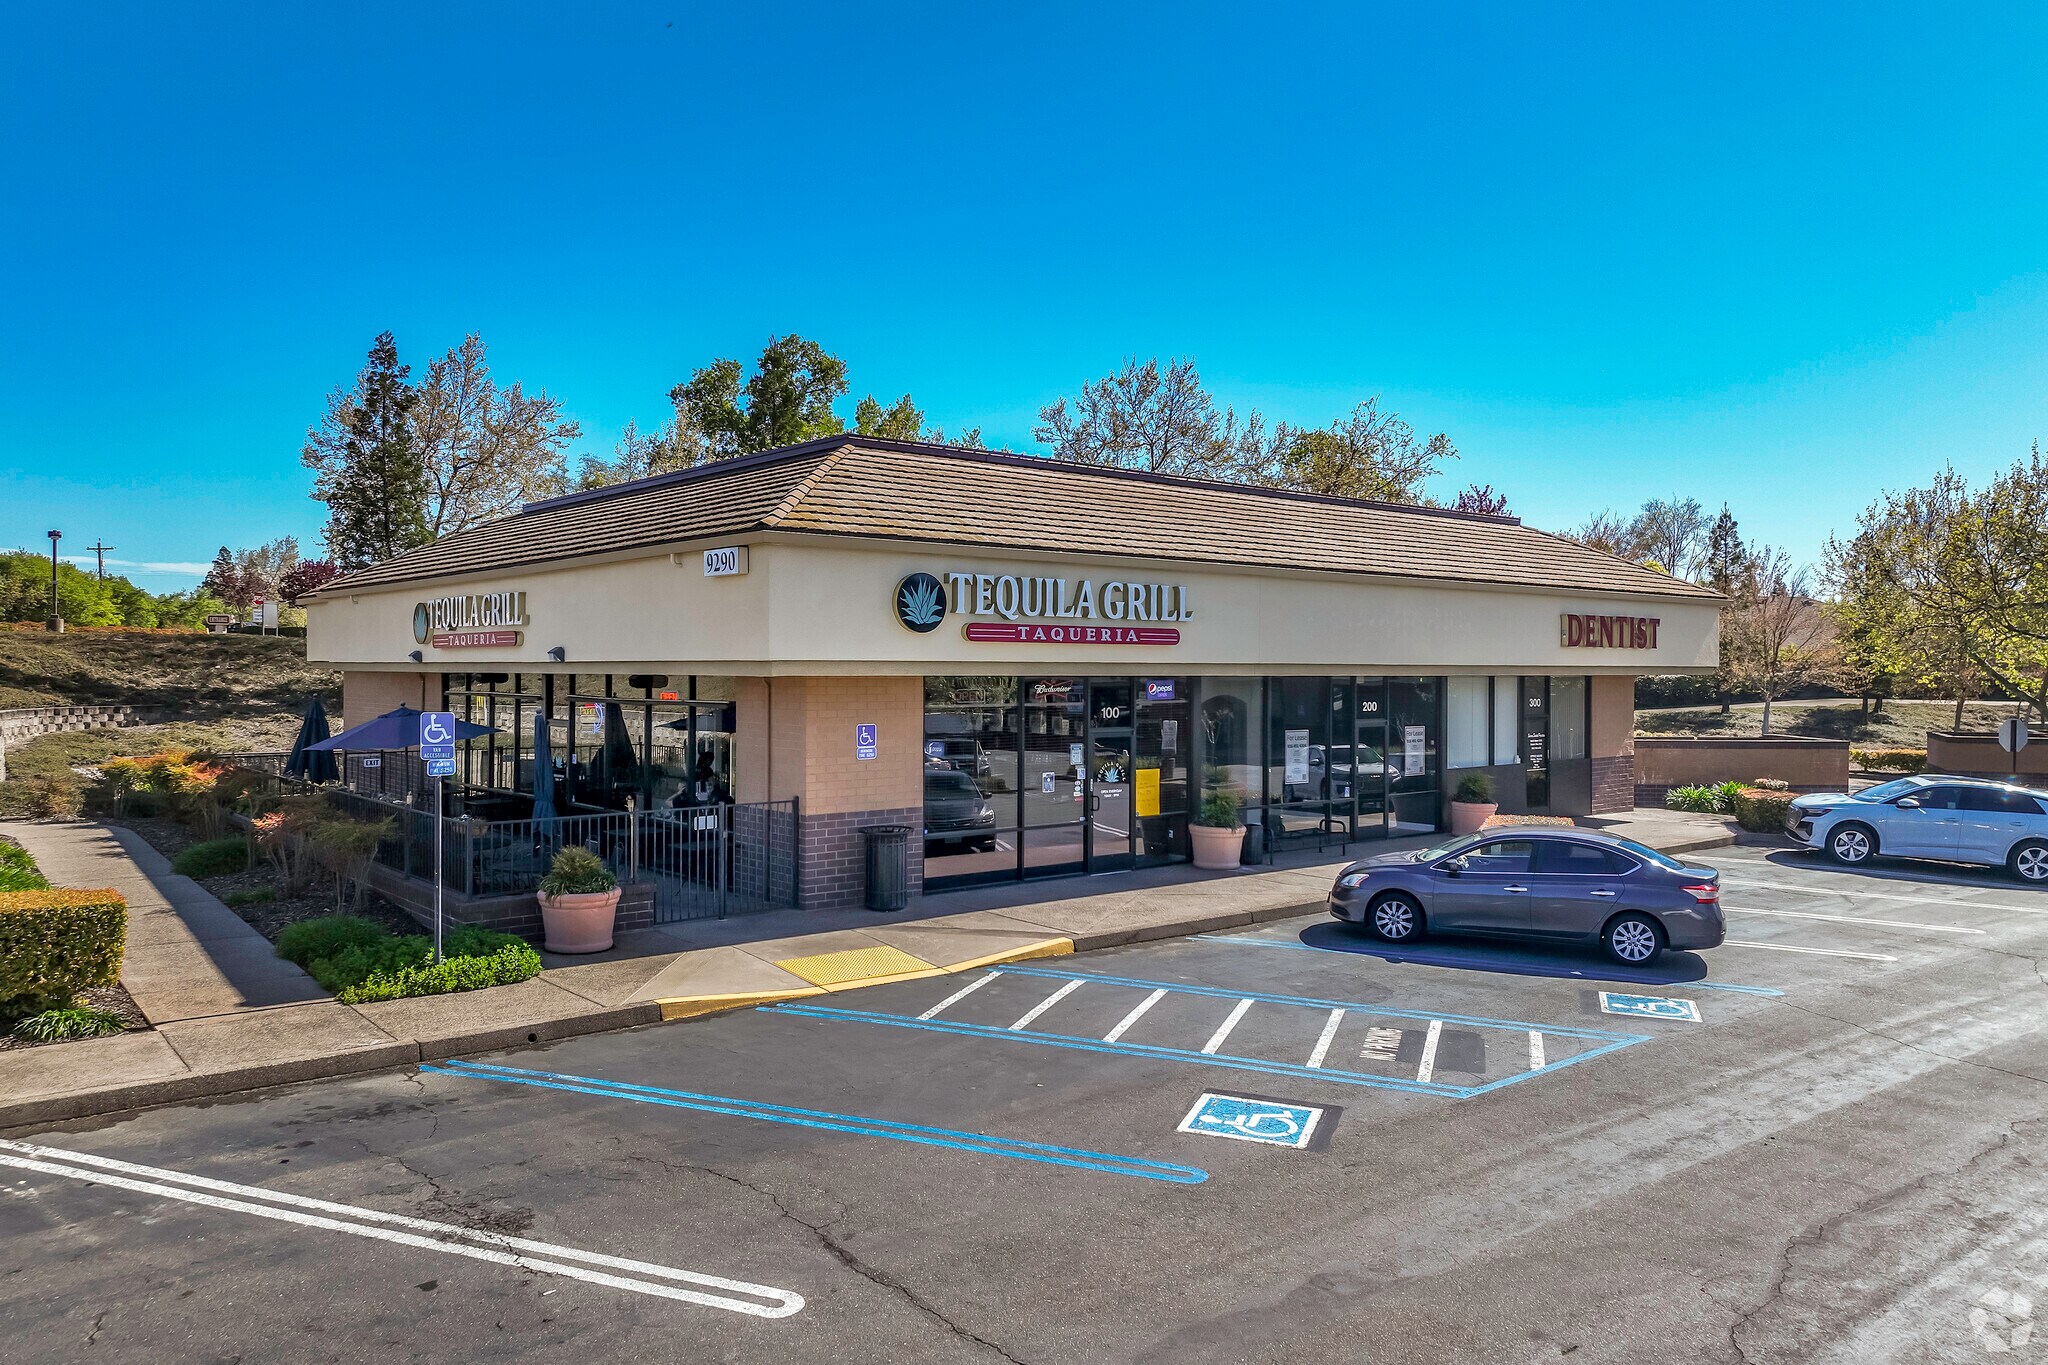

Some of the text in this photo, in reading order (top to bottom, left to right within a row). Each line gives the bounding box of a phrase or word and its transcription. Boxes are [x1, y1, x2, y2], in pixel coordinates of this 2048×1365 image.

[706, 551, 735, 573] 9290
[949, 572, 1194, 622] TEQUILA GRILL
[428, 591, 523, 631] TEQUILA GRILL
[1018, 626, 1139, 642] TAQUERIA
[1567, 614, 1660, 649] DENTIST
[448, 633, 497, 646] TAQUERIA
[1156, 684, 1173, 694] pepsi
[1362, 701, 1378, 712] 200
[1529, 698, 1541, 707] 300
[1101, 706, 1120, 719] 100
